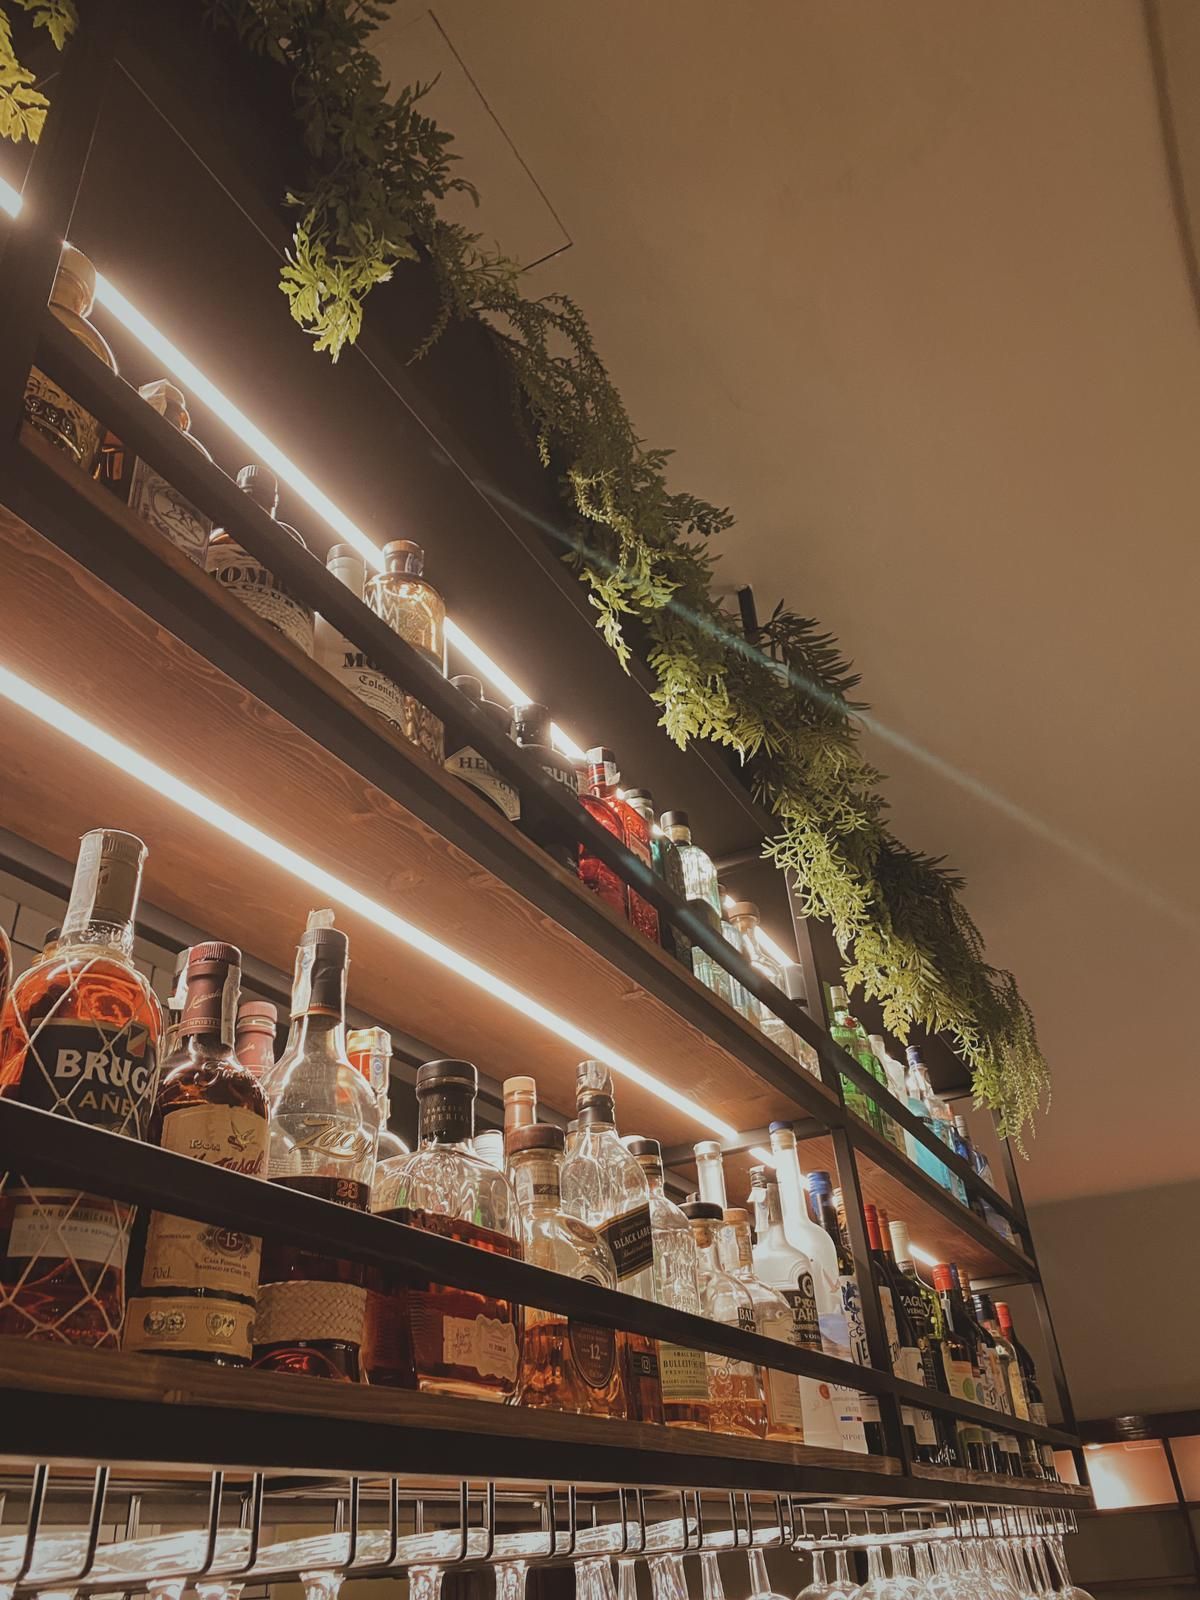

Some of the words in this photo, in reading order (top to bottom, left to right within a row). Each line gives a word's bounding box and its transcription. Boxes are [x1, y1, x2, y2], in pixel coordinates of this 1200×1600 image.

[335, 1180, 359, 1200] 23
[225, 1231, 239, 1248] 15
[613, 1232, 637, 1250] BLACK
[589, 1343, 601, 1360] 12
